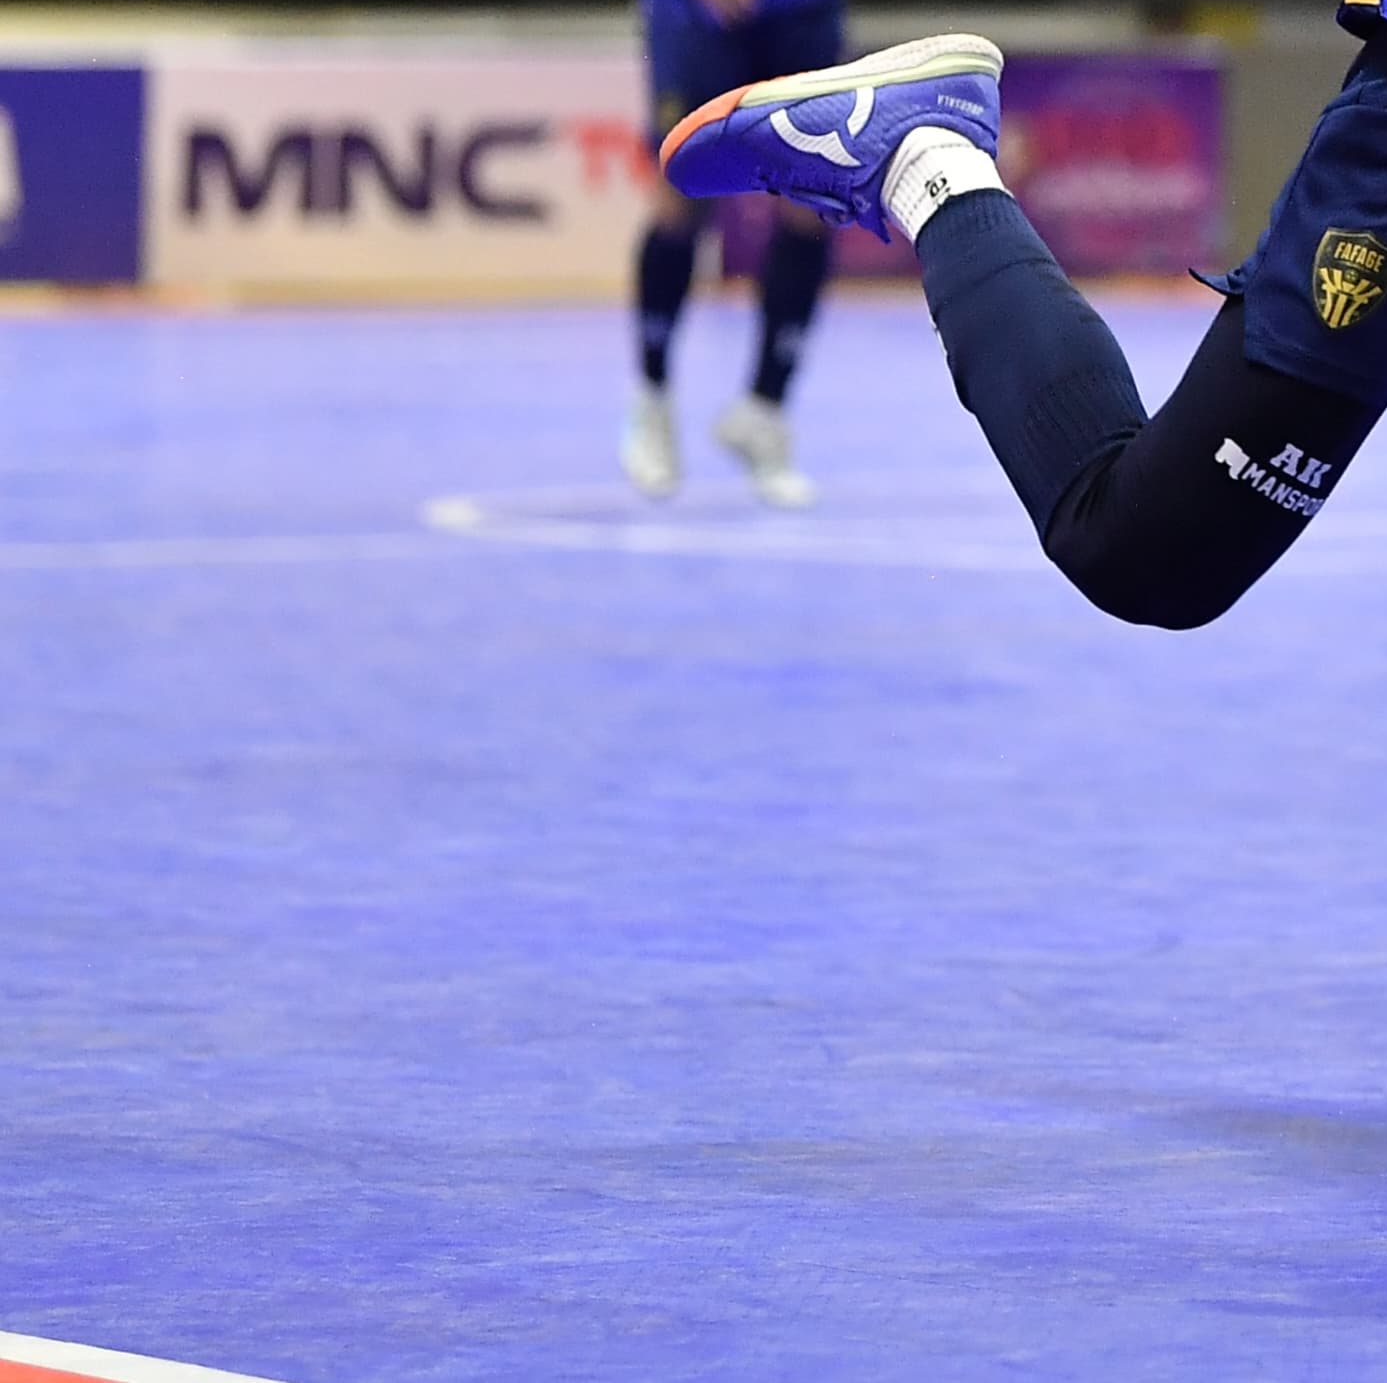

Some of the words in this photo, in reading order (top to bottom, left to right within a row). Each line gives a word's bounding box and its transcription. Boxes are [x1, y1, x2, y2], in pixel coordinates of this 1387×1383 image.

[182, 117, 552, 226] MNC
[1334, 241, 1384, 272] FAFAGE
[1269, 442, 1332, 489] AK
